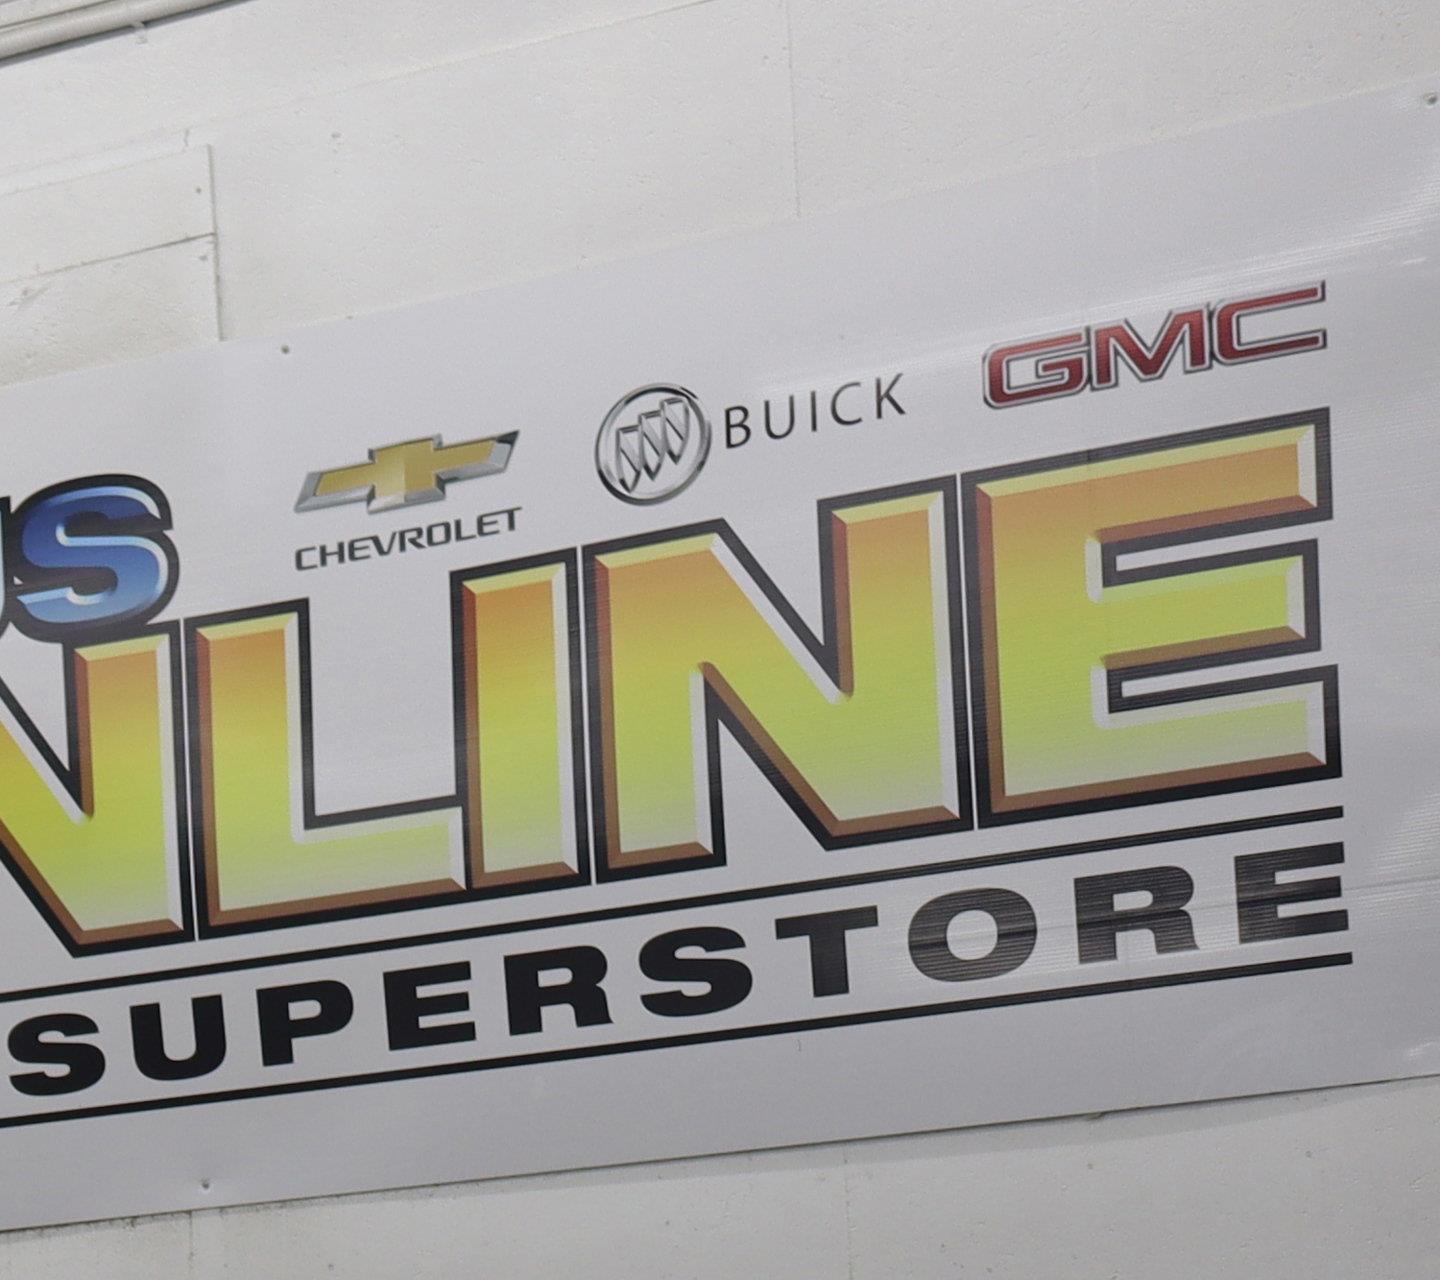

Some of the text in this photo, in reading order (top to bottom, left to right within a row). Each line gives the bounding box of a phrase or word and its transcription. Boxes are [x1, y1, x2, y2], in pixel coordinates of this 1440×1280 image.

[982, 280, 1328, 410] GMC
[724, 375, 906, 450] BUICK
[293, 507, 521, 572] CHEVROLET
[8, 842, 1348, 1098] SUPERSTORE
